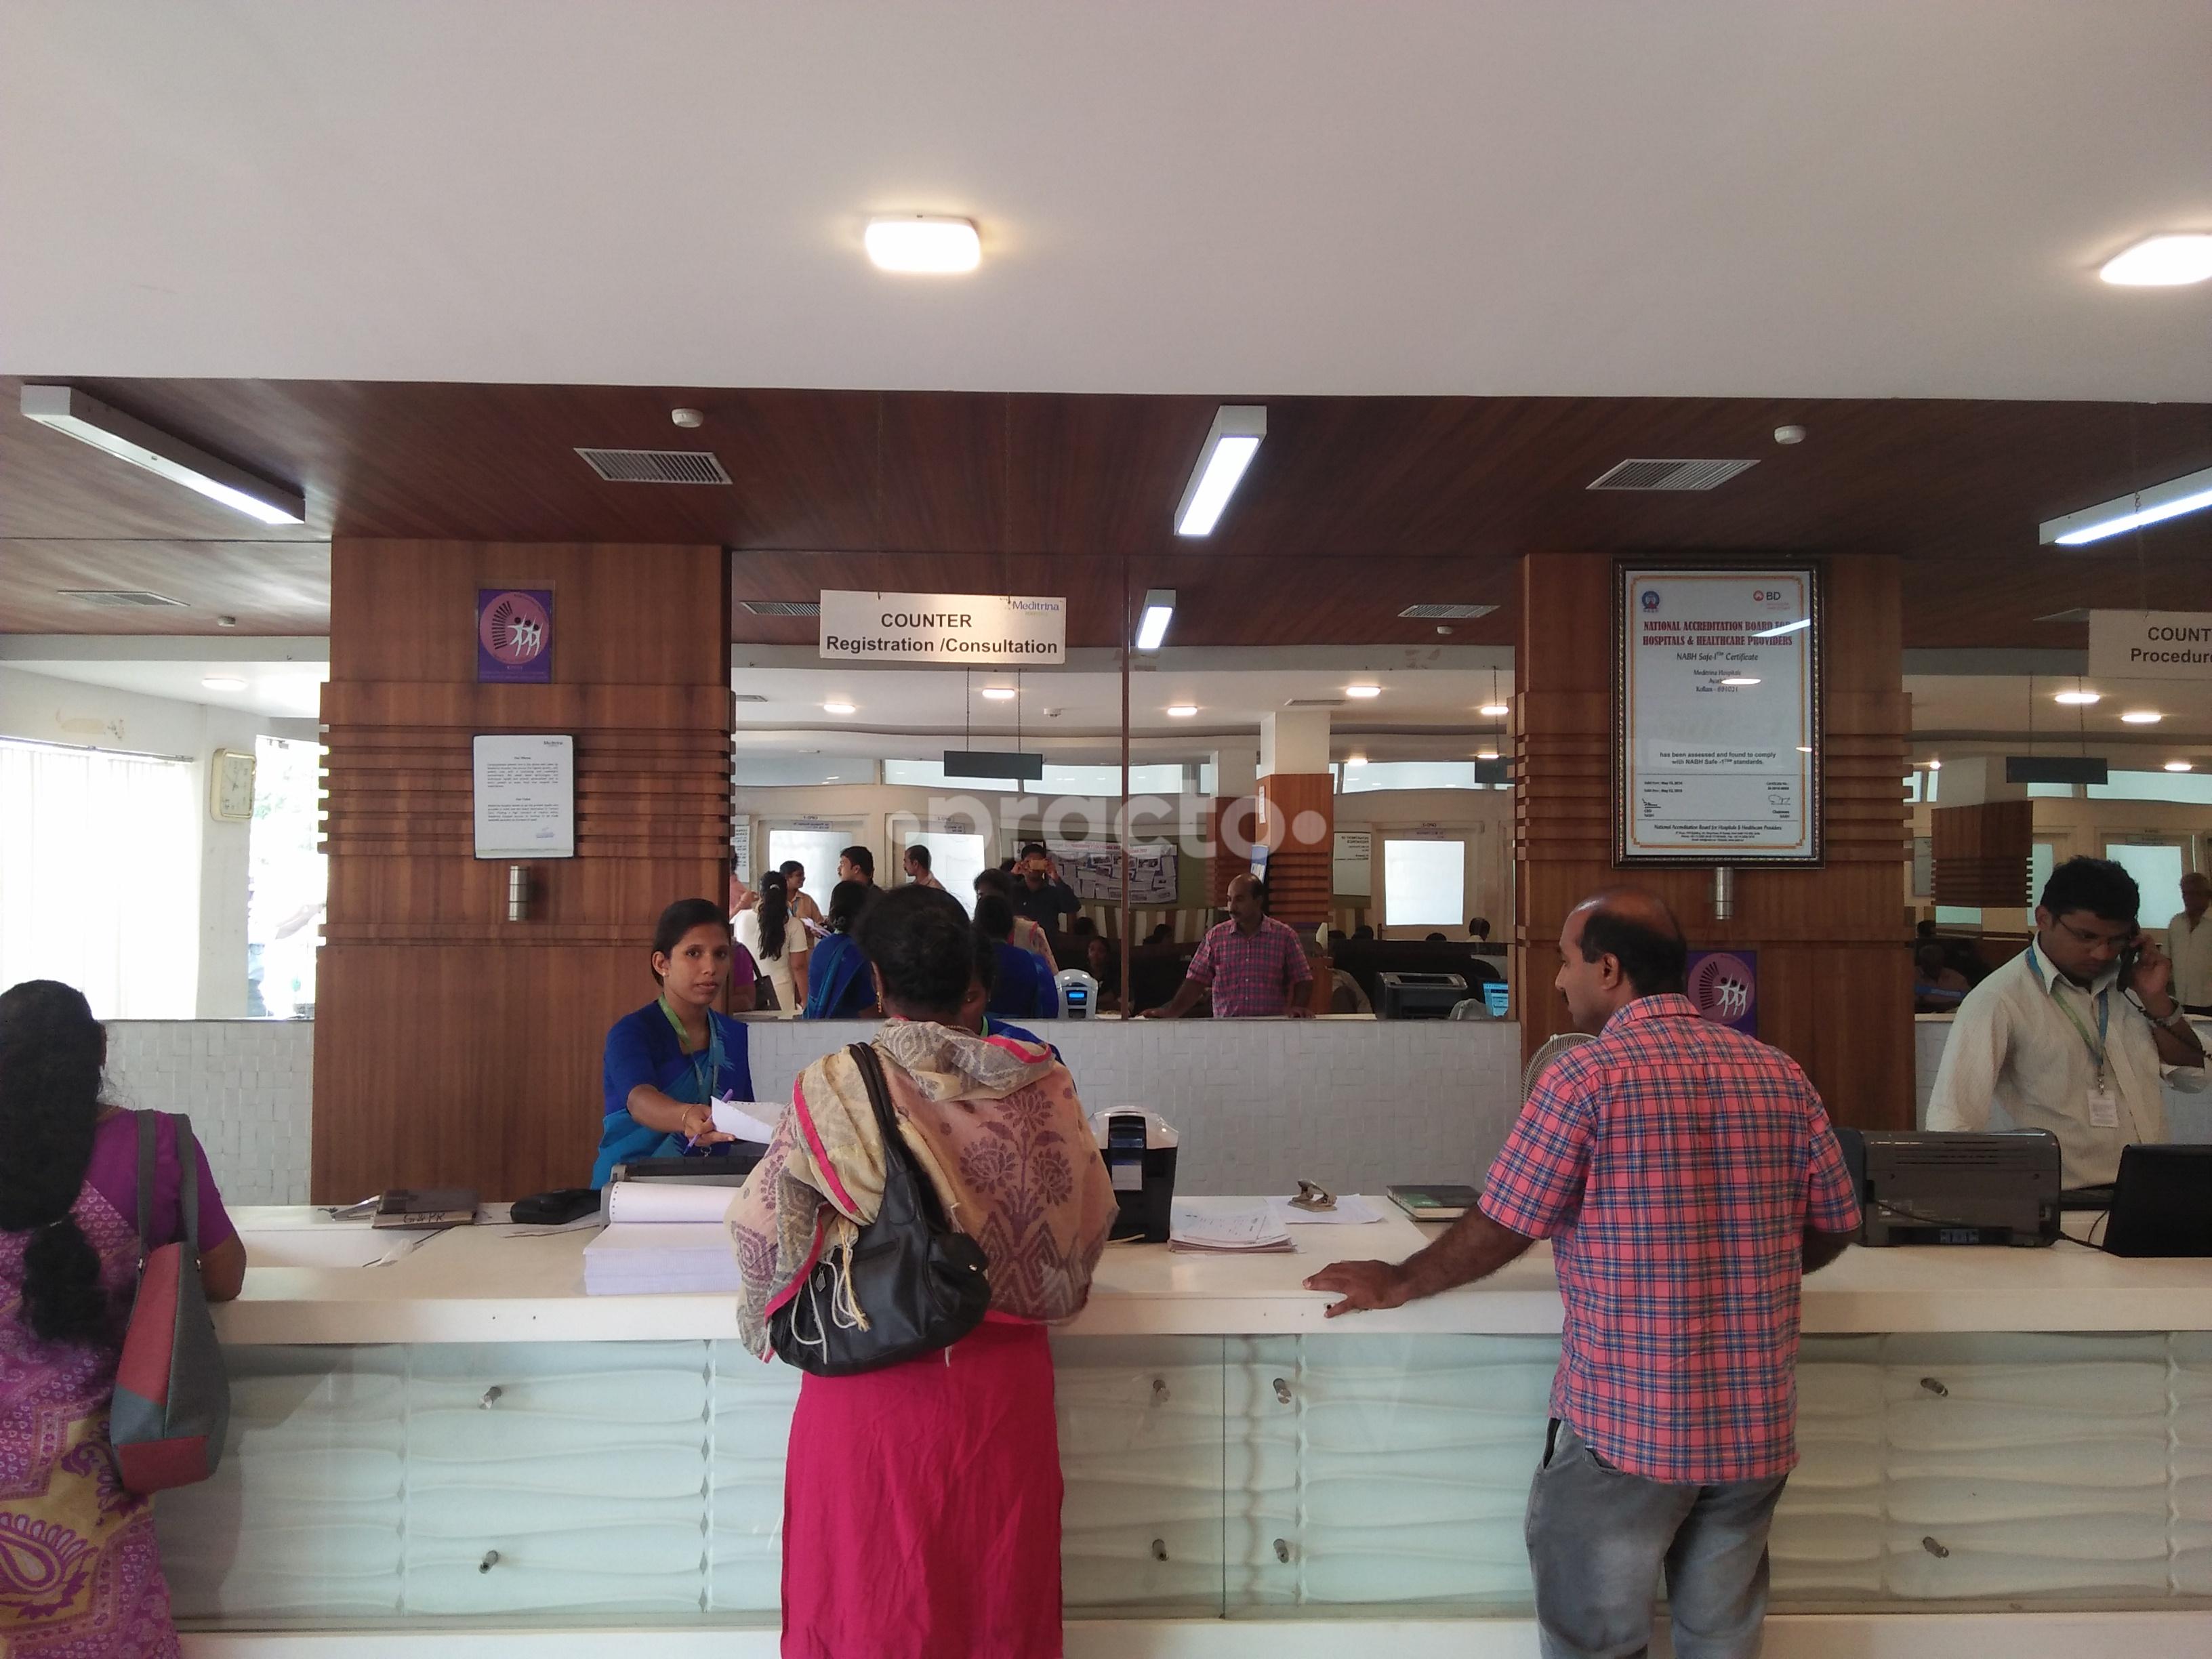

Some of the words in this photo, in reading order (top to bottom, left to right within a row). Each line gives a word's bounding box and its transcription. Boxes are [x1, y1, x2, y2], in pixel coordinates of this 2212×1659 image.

[1766, 592, 1781, 600] BD
[1012, 600, 1059, 611] Meditrina
[881, 613, 972, 628] COUNTER
[1643, 621, 1681, 631] NATIONAL
[1683, 621, 1743, 631] ACCREDITATION
[826, 636, 934, 654] Registration
[940, 637, 1058, 653] /Consultation
[1643, 636, 1685, 645] HOSPITALS
[1687, 636, 1694, 645] &
[1696, 636, 1745, 645] HEALTHCARE
[1748, 636, 1793, 645] PROVIDERS
[1677, 652, 1697, 661] NABH
[1725, 653, 1759, 662] Certificate
